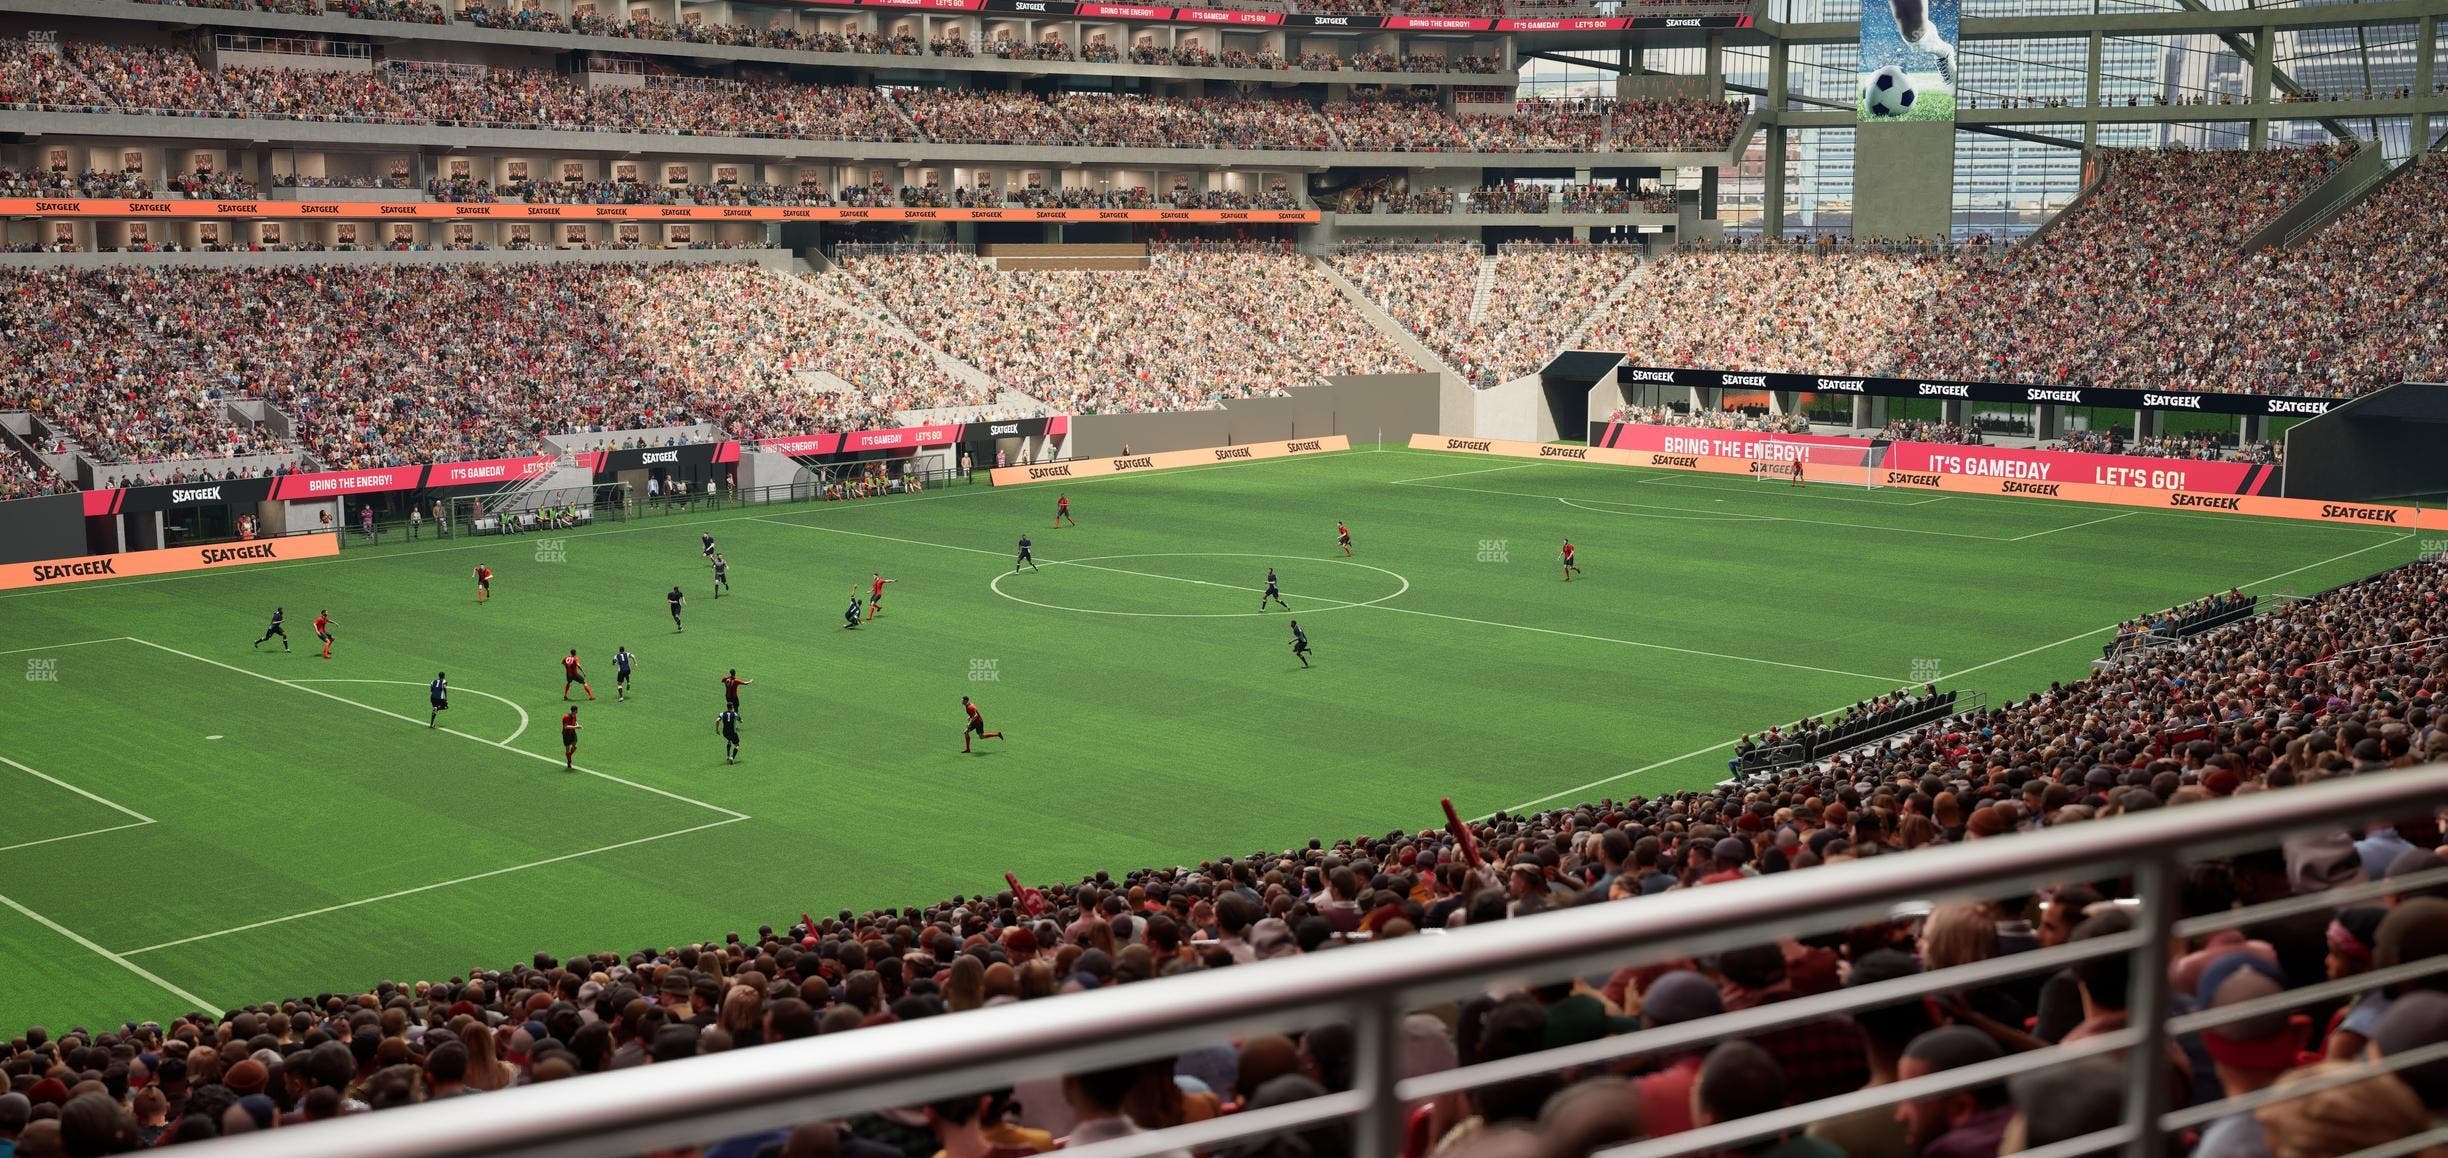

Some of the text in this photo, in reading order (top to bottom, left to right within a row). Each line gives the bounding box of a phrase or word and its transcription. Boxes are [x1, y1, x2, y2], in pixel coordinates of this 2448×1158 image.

[1016, 2, 1045, 11] SEATGEEK
[1130, 9, 1153, 17] ENERGY!
[1315, 17, 1347, 26] SEATGEEK
[1666, 19, 1700, 28] SEATGEEK
[36, 203, 80, 212] SEATGEEK
[130, 204, 171, 212] SEATGEEK
[218, 204, 258, 212] SEATGEEK
[302, 205, 338, 213] SEATGEEK
[381, 206, 416, 214] SEATGEEK
[528, 207, 560, 215] SEATGEEK
[662, 208, 691, 216] SEATGEEK
[783, 209, 810, 217] SEATGEEK
[1037, 211, 1066, 219] SEATGEEK
[1633, 369, 1674, 383] SEATGEEK
[1722, 374, 1766, 388] SEATGEEK
[1818, 378, 1864, 392] SEATGEEK
[1919, 383, 1969, 397] SEATGEEK
[2028, 388, 2081, 403] SEATGEEK
[2144, 393, 2201, 408] SEATGEEK
[2268, 400, 2330, 414] SEATGEEK
[991, 424, 1018, 436] SEATGEEK
[875, 434, 902, 444] GAMEDAY
[1447, 439, 1491, 452] SEATGEEK
[1287, 440, 1321, 453] SEATGEEK
[1540, 446, 1587, 460] SEATGEEK
[1664, 437, 1810, 462] BRING THE ENERGY!
[643, 450, 678, 464] SEATGEEK
[1215, 447, 1251, 461] SEATGEEK
[1652, 454, 1698, 468] SEATGEEK
[1114, 456, 1153, 471] SEATGEEK
[1929, 455, 2050, 480] IT'S GAMEDAY
[452, 466, 505, 480] IT'S GAMEDAY
[1030, 465, 1070, 479] SEATGEEK
[2096, 467, 2184, 489] LET'S GO!
[309, 475, 392, 492] BRING THE ENERGY!
[1888, 472, 1941, 487] SEATGEEK
[172, 486, 222, 503] SEATGEEK
[2002, 481, 2059, 496] SEATGEEK
[2171, 494, 2241, 510] SEATGEEK
[2321, 504, 2397, 523] SEATGEEK
[201, 542, 277, 564] SEATGEEK
[33, 558, 116, 582] SEATGEEK
